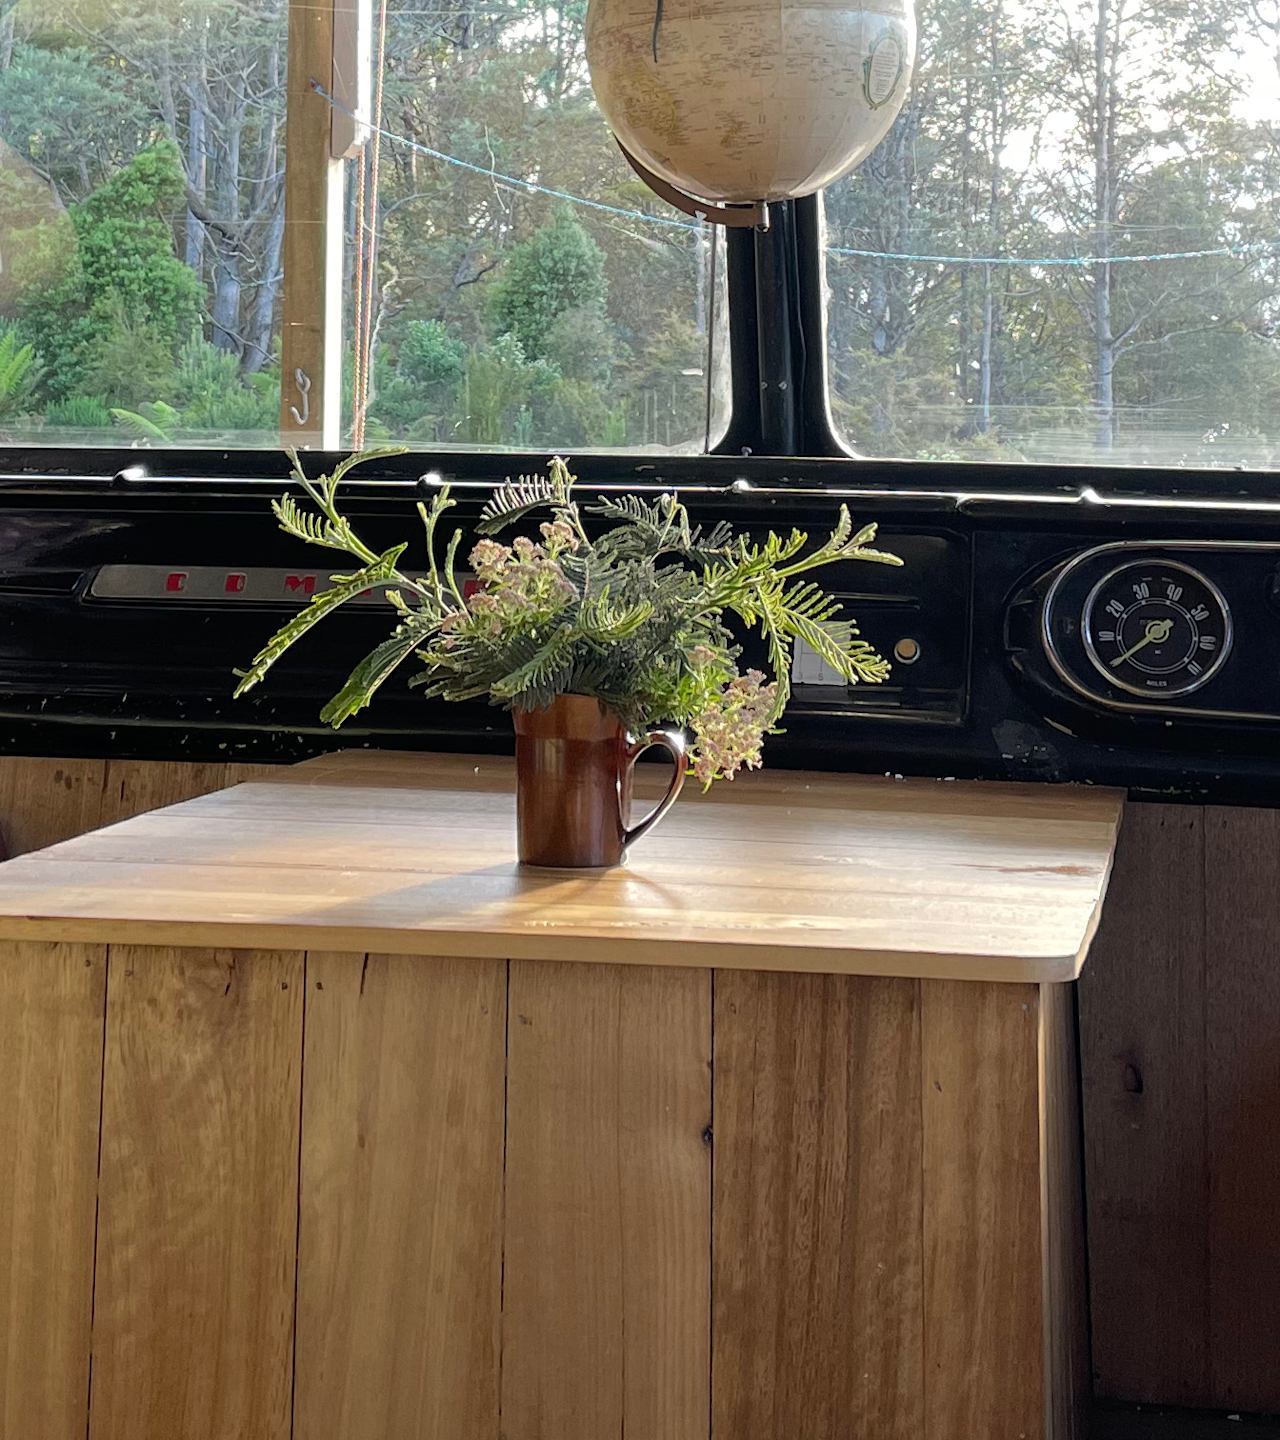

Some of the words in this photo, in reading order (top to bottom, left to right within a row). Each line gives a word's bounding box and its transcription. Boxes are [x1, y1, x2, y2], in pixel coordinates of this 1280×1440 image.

[1132, 582, 1150, 600] 30
[1166, 583, 1183, 602] 40
[1105, 599, 1125, 618] 20
[1190, 603, 1210, 621] 50
[1098, 630, 1115, 642] 10
[1199, 635, 1217, 651] 60
